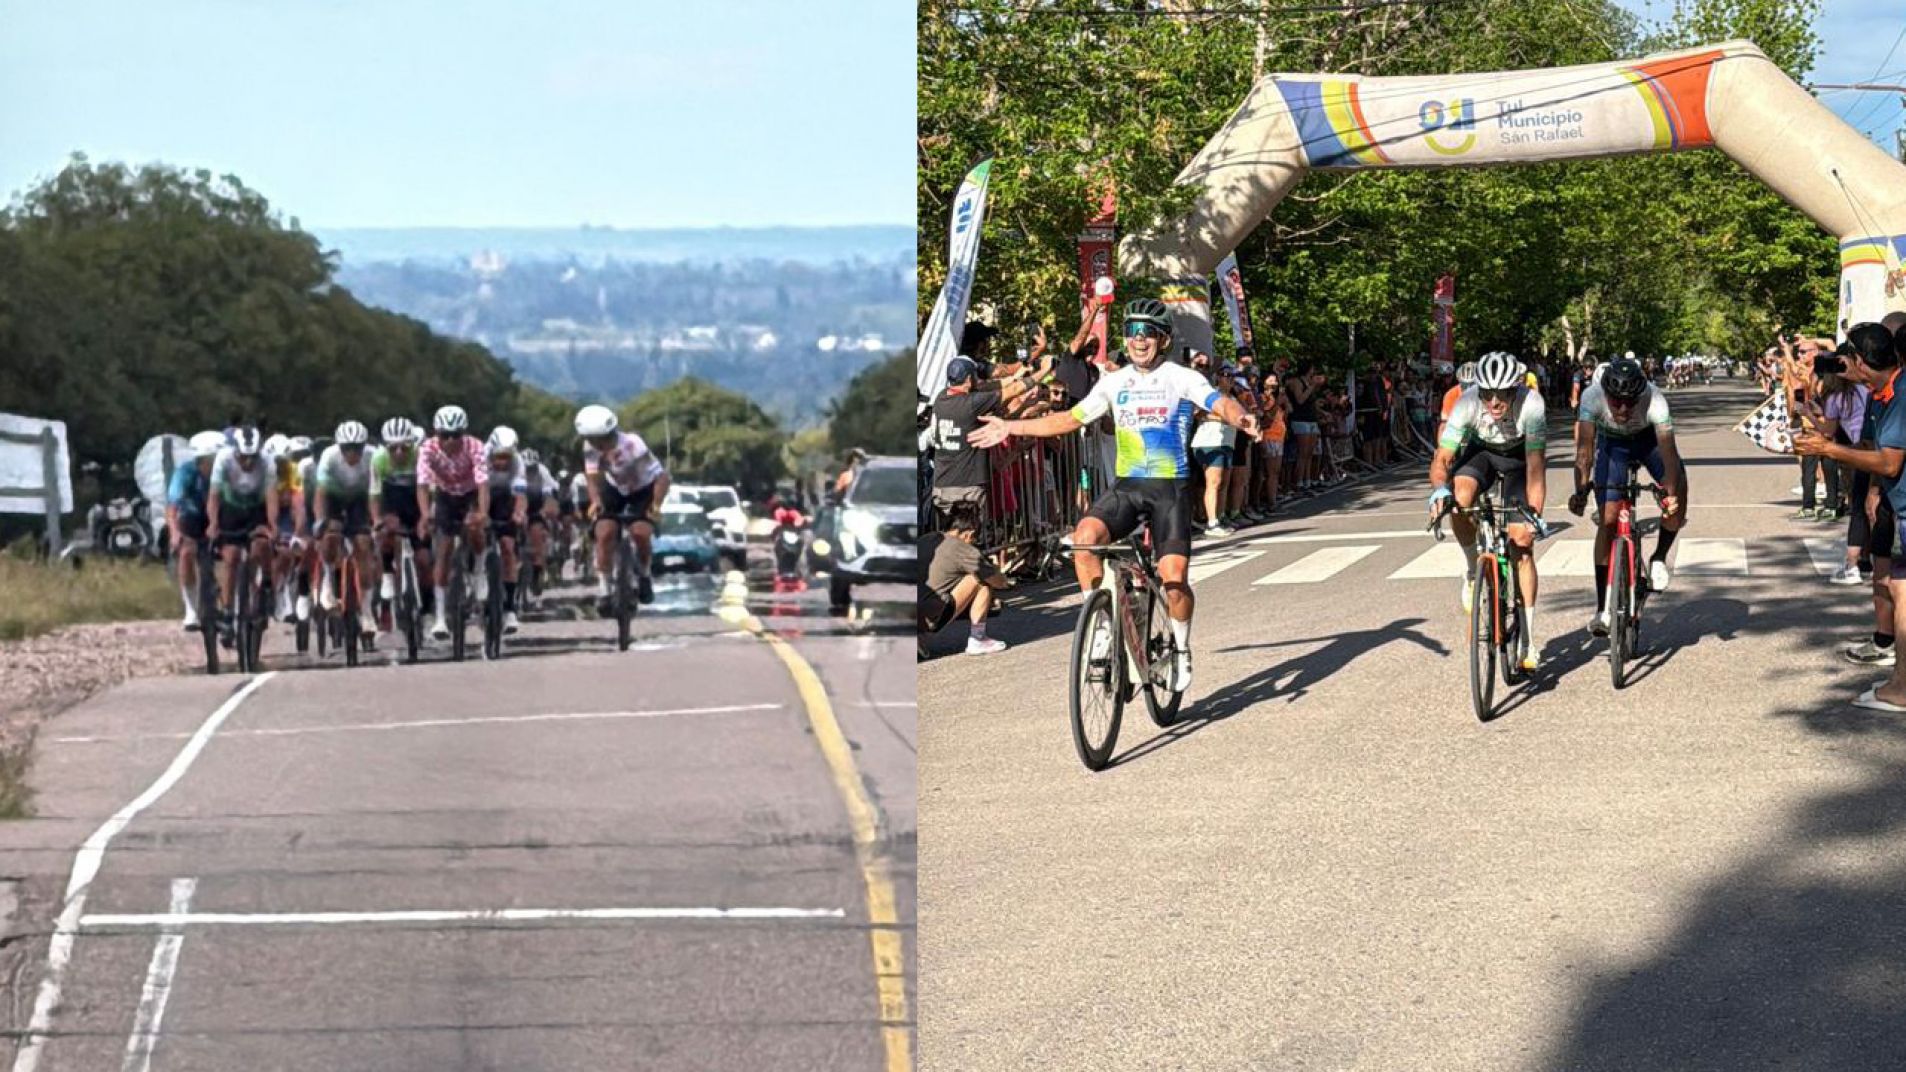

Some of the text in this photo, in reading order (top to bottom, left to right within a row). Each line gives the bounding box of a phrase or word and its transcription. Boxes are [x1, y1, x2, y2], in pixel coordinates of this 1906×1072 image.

[1497, 109, 1583, 128] Municipio
[1500, 126, 1584, 144] San Rafael
